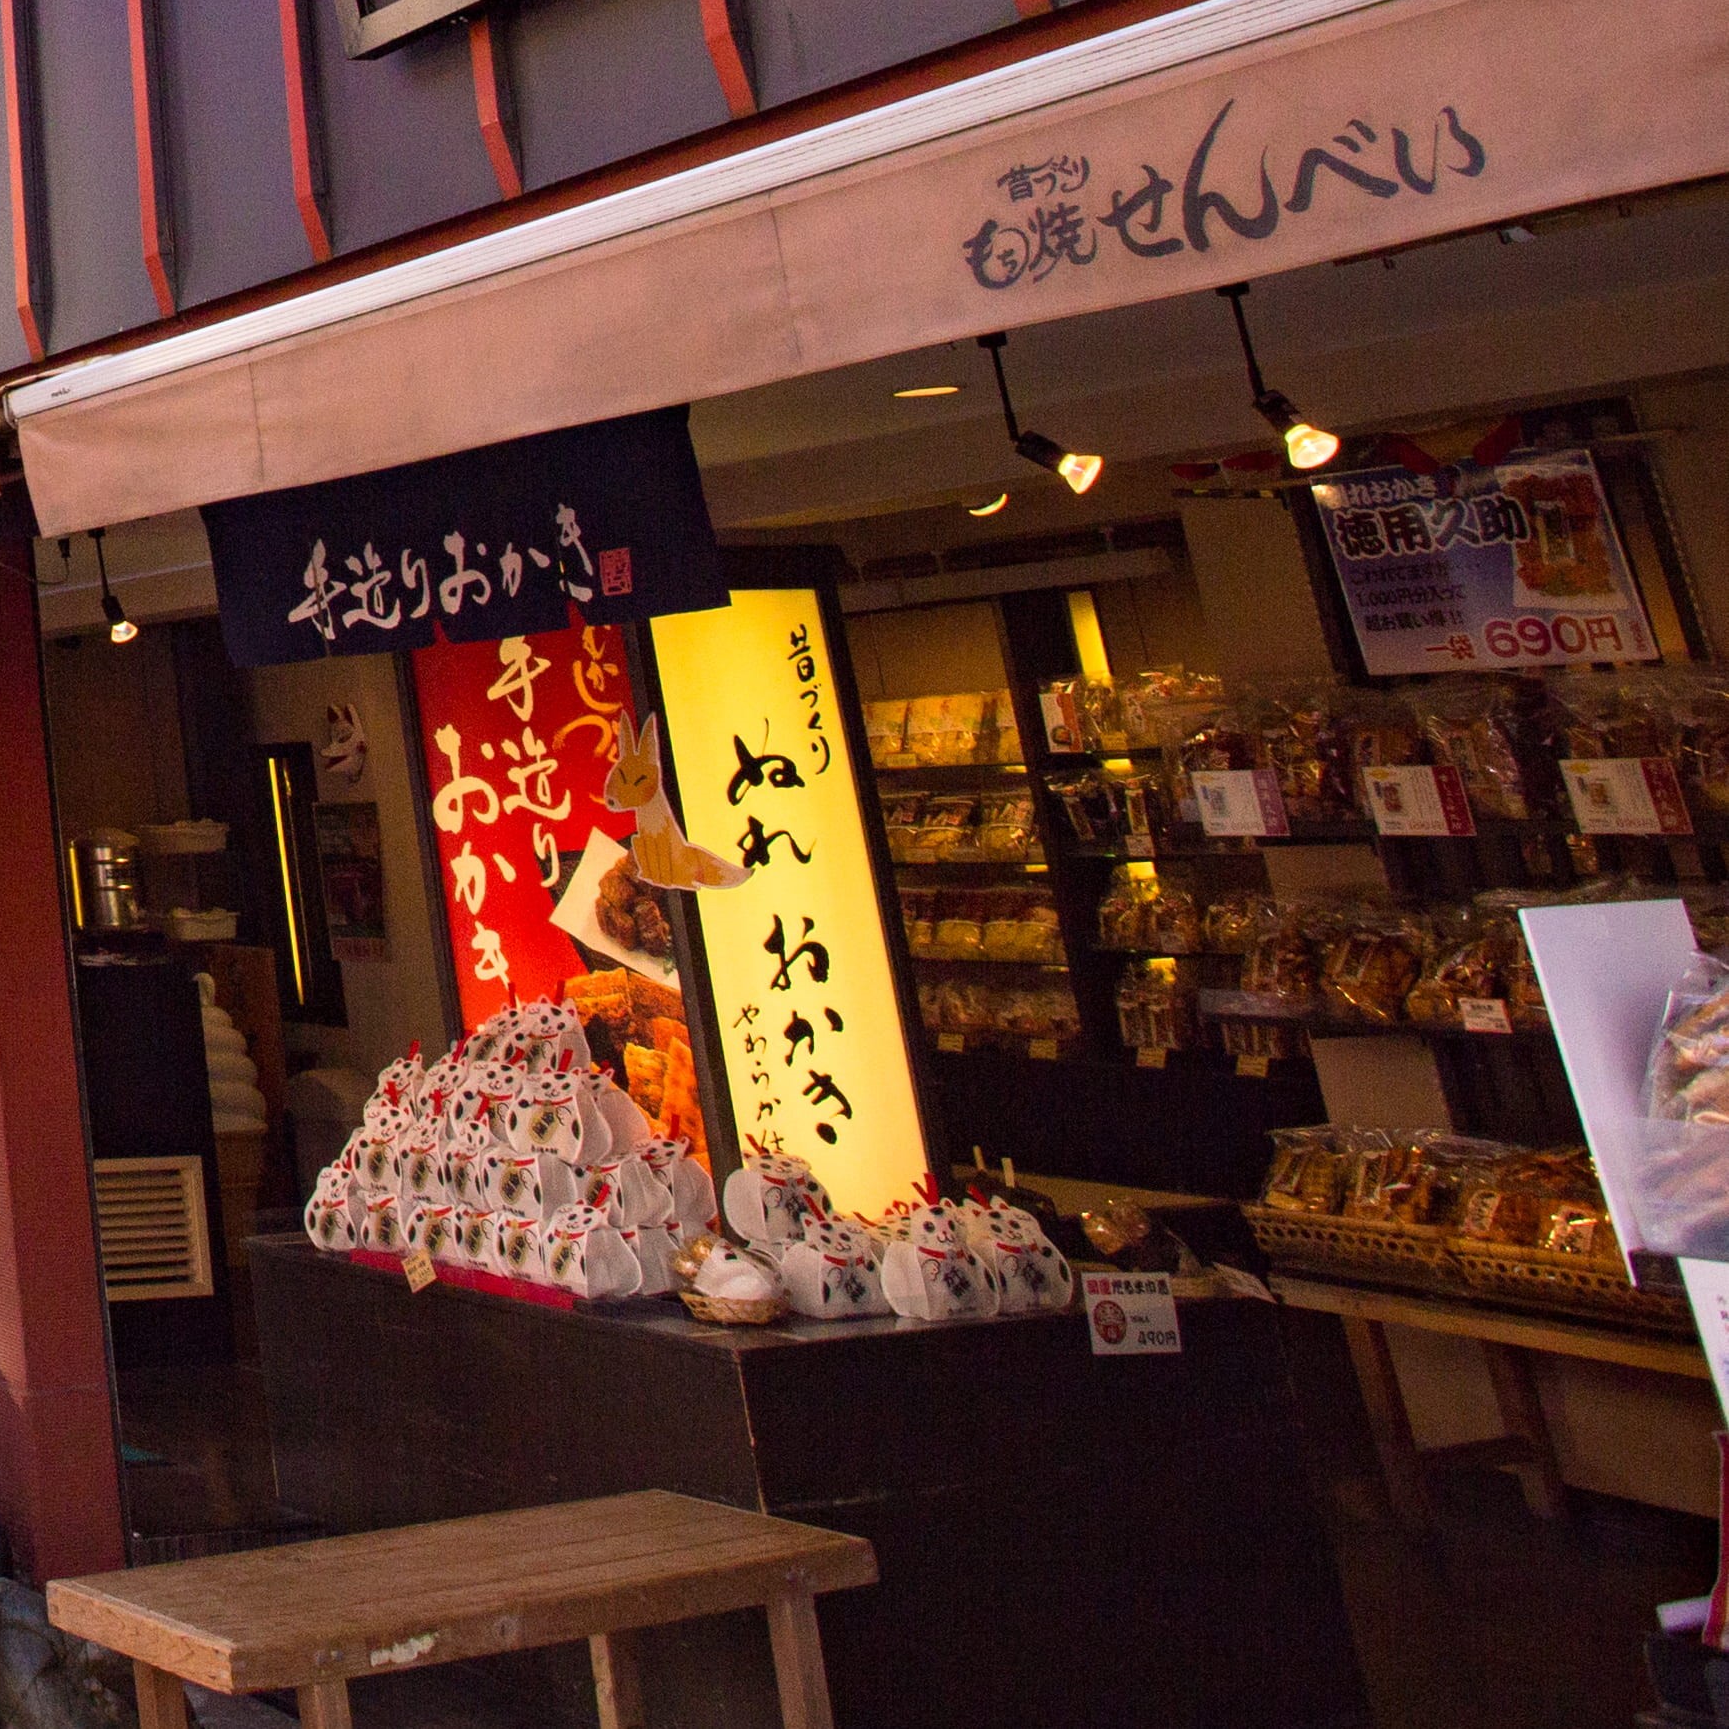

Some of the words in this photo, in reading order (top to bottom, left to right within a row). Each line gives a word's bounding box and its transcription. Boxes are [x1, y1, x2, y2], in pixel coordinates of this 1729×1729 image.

[997, 154, 1090, 203] 昔づくり
[287, 501, 594, 641] 手造りおかき
[1336, 495, 1528, 558] 徳用久助
[787, 622, 831, 776] 昔づくり
[1483, 615, 1623, 658] 690円
[487, 634, 572, 888] 手造り
[433, 723, 518, 1012] おかき
[733, 1003, 786, 1153] やわらか仕
[1138, 1330, 1177, 1346] 490円
